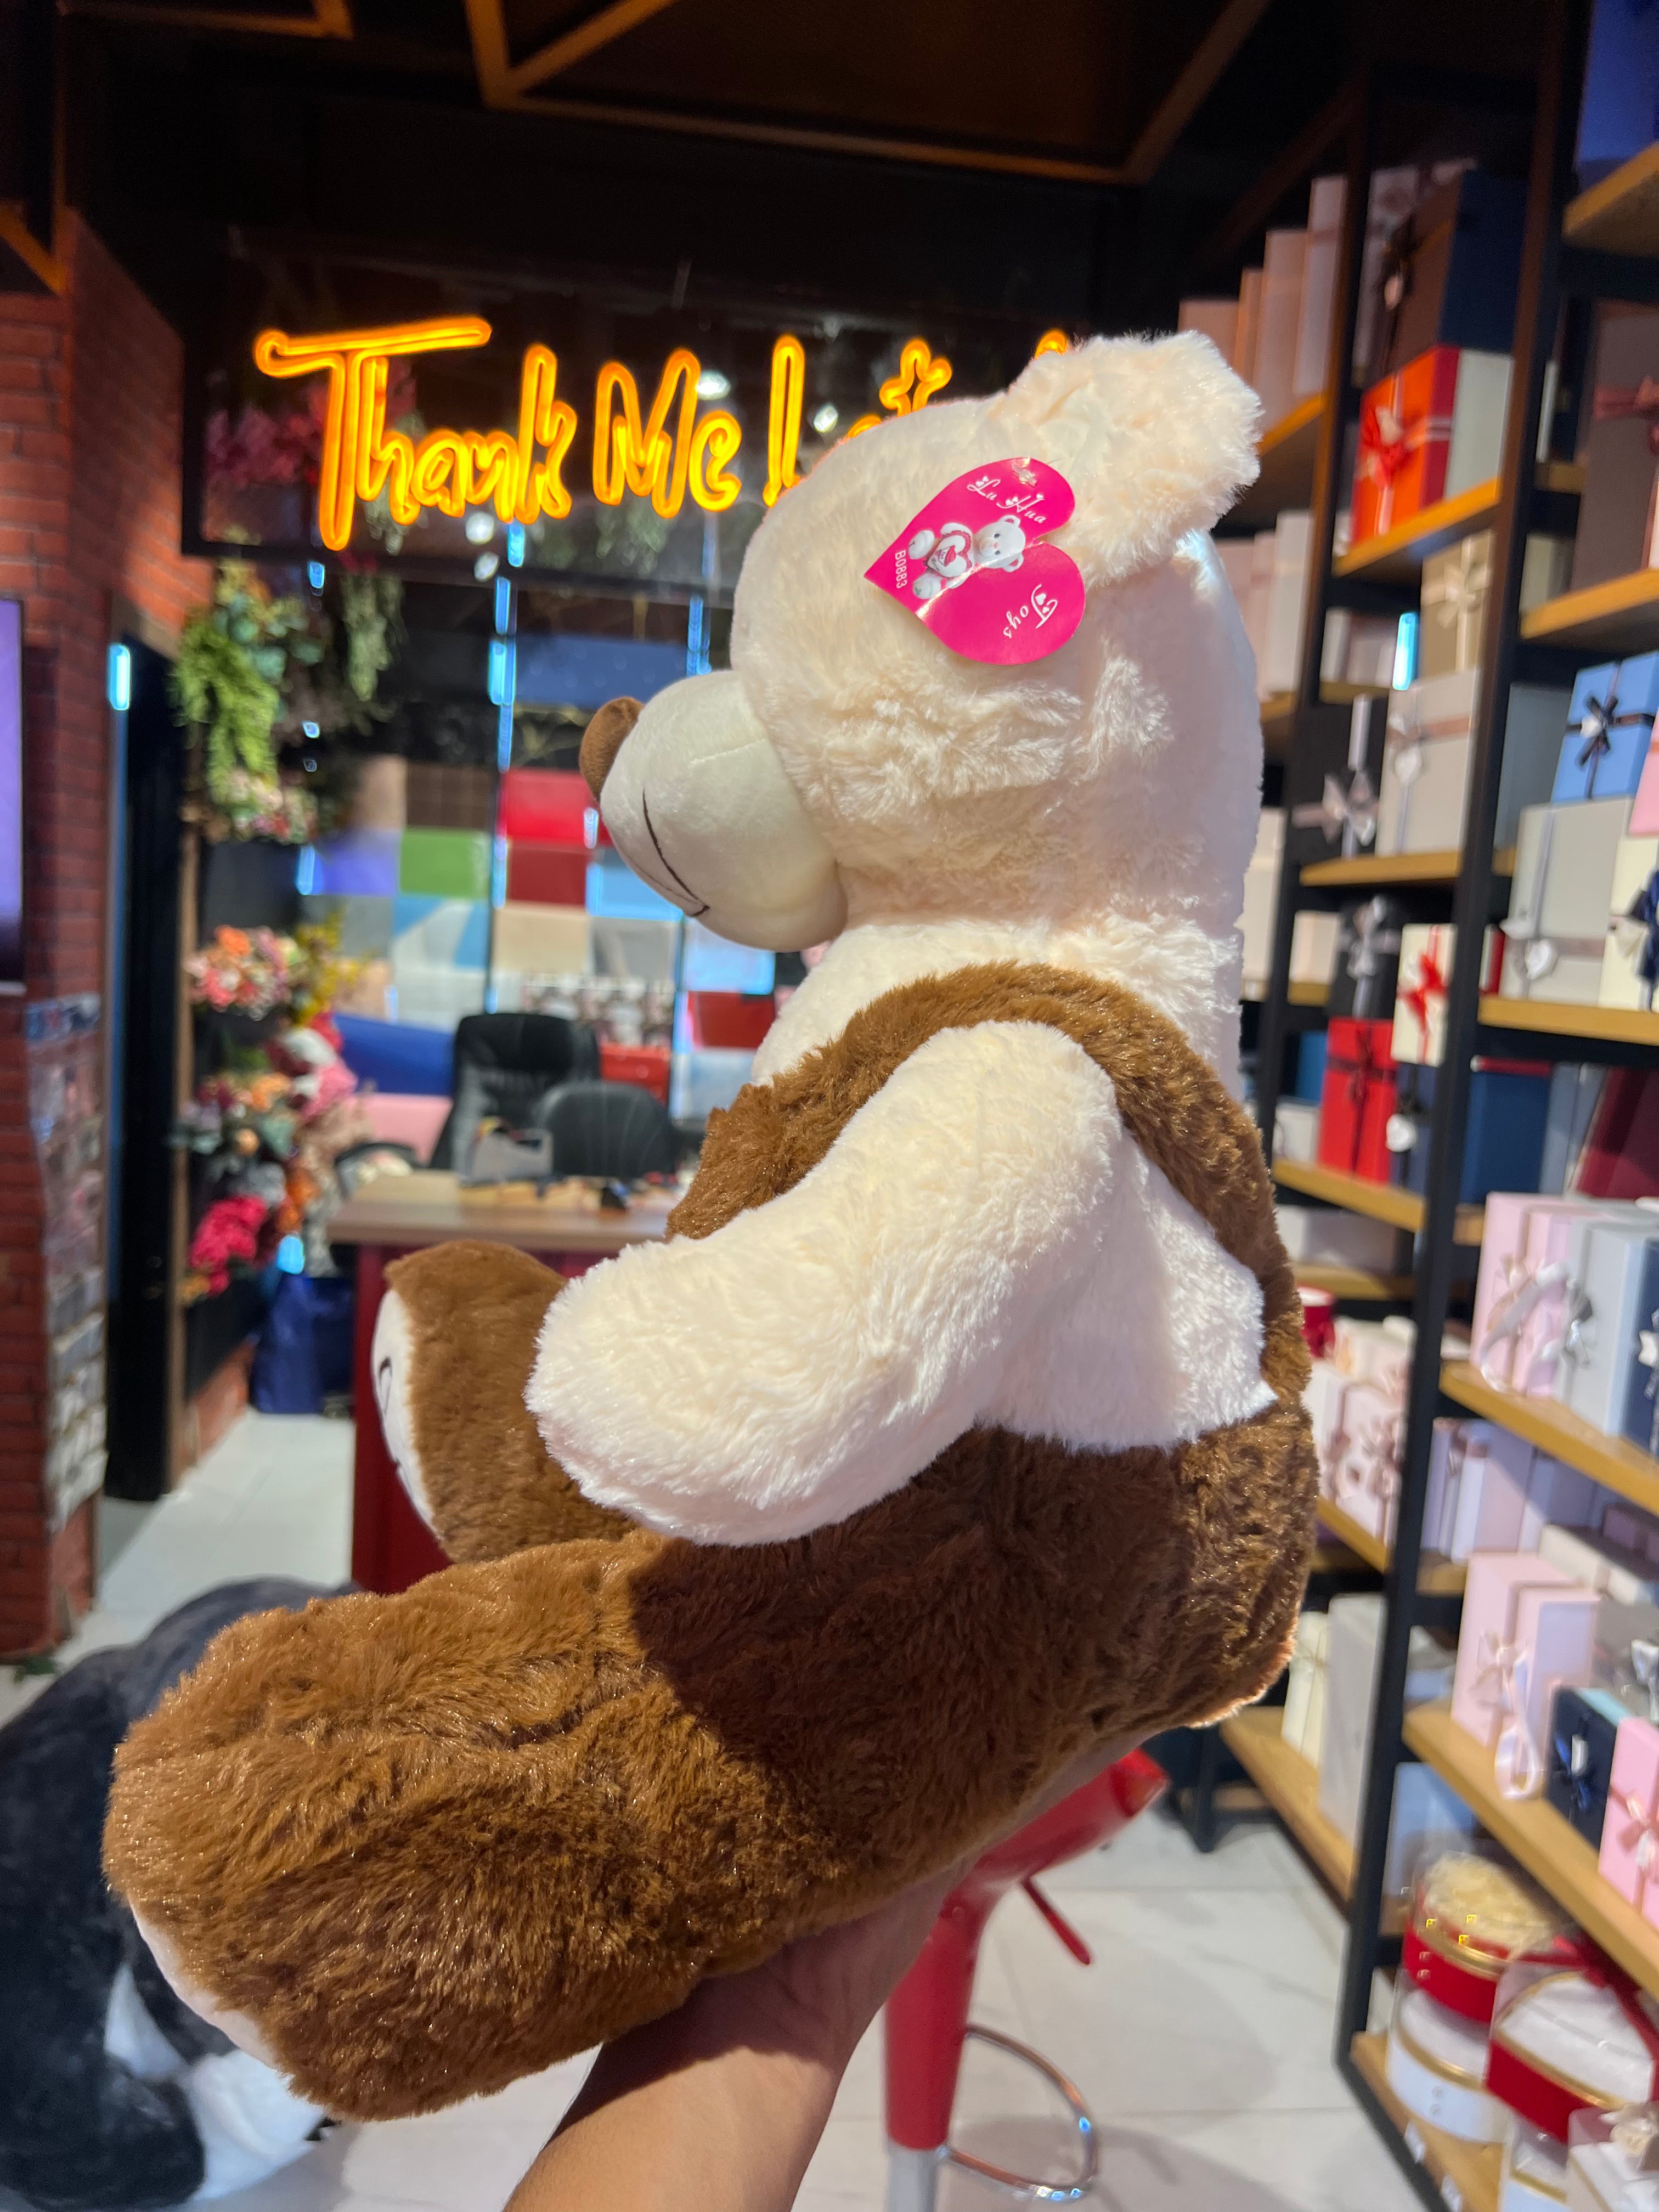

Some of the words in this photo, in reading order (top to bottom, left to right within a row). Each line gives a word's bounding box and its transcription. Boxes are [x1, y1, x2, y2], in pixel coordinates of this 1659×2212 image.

[255, 315, 578, 551] Thank
[592, 348, 742, 519] Me
[967, 476, 1001, 501] Lu
[996, 493, 1046, 524] Hua
[895, 549, 907, 589] B0883
[1003, 584, 1058, 639] Toys
